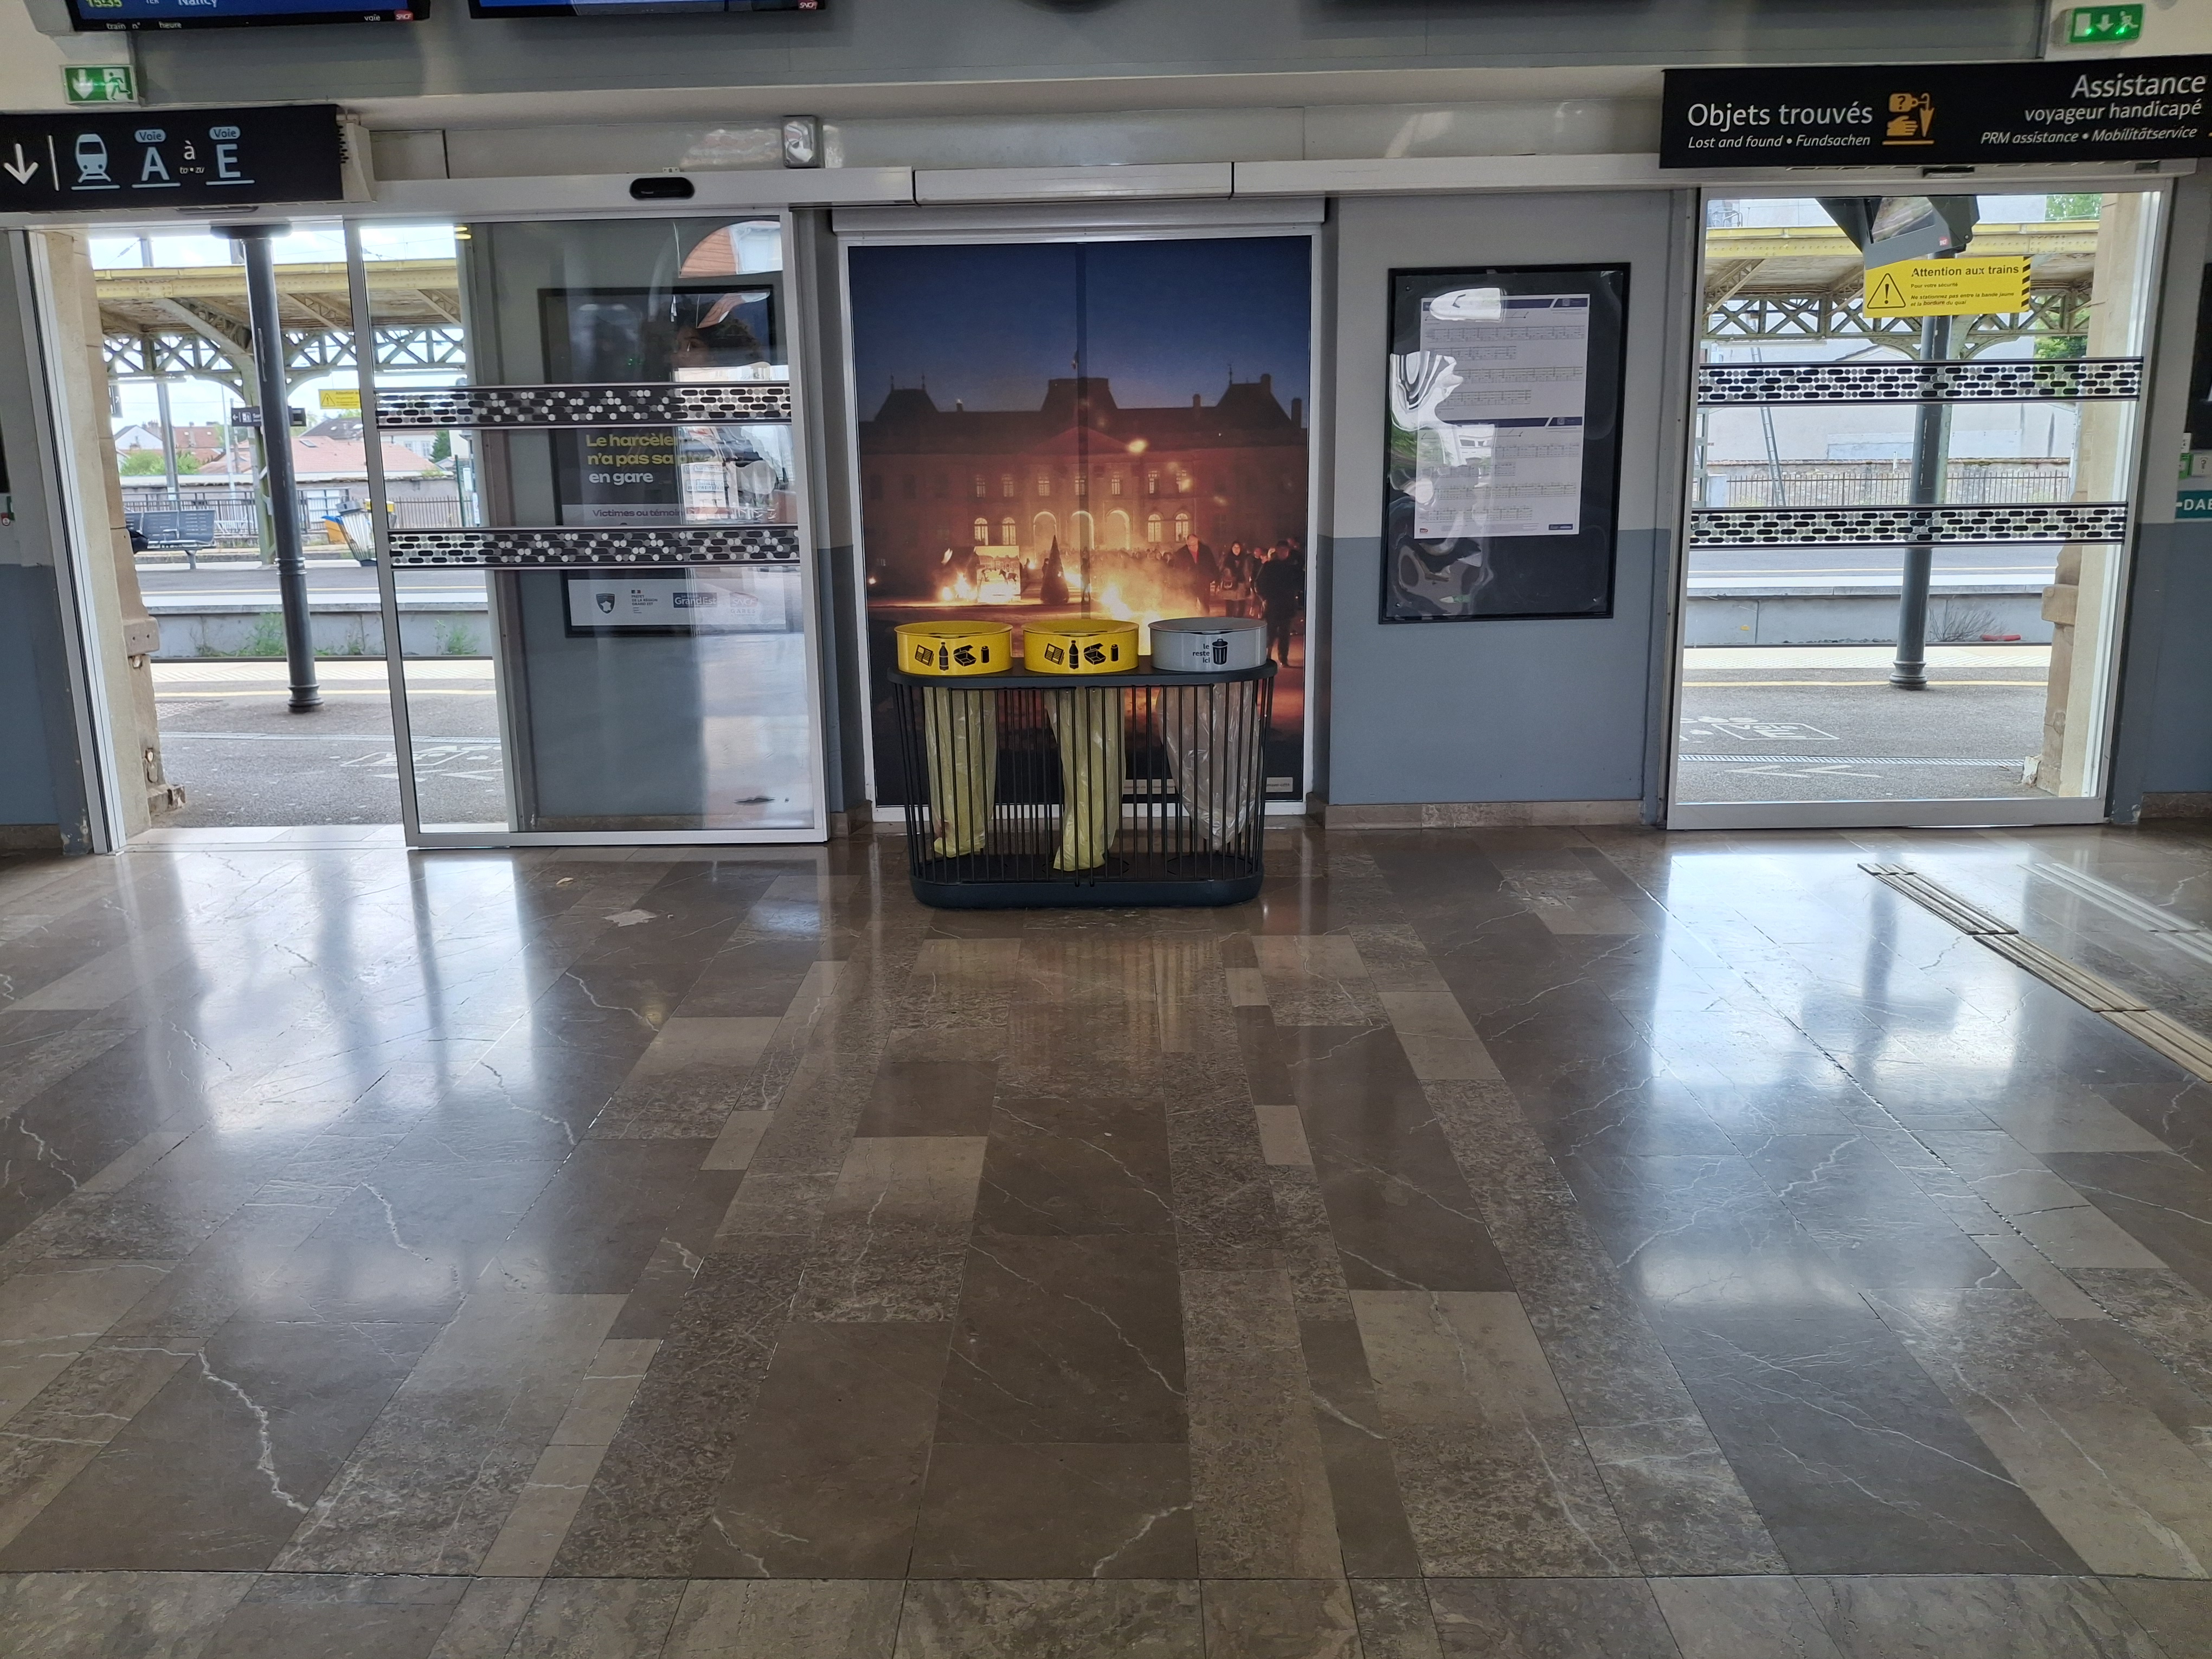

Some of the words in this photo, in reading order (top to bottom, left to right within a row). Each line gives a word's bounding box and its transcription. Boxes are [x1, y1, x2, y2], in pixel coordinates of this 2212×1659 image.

[2070, 73, 2206, 99] Assistance
[1688, 102, 1770, 132] Objets
[1779, 101, 1873, 125] trouvés
[2024, 107, 2105, 125] voyageur
[2109, 99, 2202, 120] handicapé
[139, 131, 162, 141] Voie
[213, 128, 236, 138] Voie
[1980, 132, 2010, 144] PRM
[2012, 131, 2079, 144] assistance
[2091, 126, 2197, 142] Mobilitätservice
[1688, 137, 1716, 148] Lost
[1719, 136, 1744, 147] and
[1745, 135, 1784, 147] found
[1796, 134, 1870, 146] Fundsachen
[141, 146, 170, 182] A
[184, 140, 196, 160] à
[216, 144, 241, 178] E
[1911, 267, 1962, 277] Attention
[1988, 265, 2019, 274] trains
[586, 434, 607, 447] Le
[610, 433, 676, 447] harcèle
[587, 453, 613, 465] n'a
[616, 454, 649, 467] pas
[652, 453, 674, 465] sa
[589, 473, 610, 484] en
[613, 472, 654, 486] gare
[593, 509, 635, 517] Victimes
[1754, 730, 1807, 738] E
